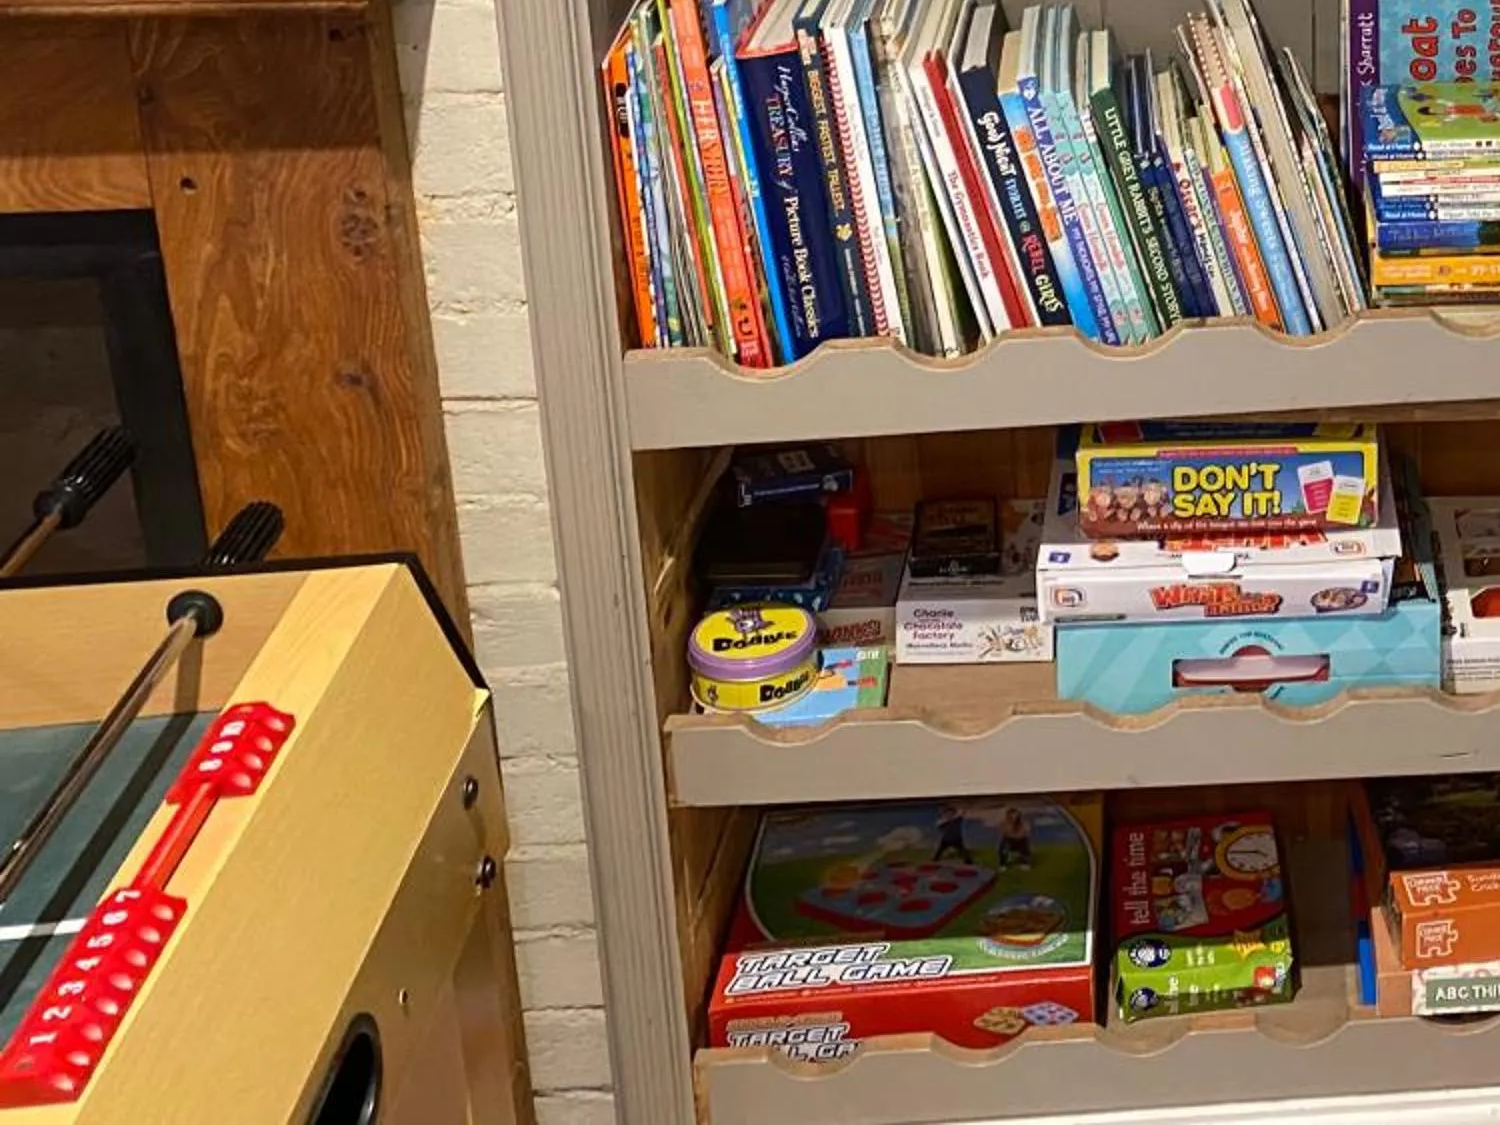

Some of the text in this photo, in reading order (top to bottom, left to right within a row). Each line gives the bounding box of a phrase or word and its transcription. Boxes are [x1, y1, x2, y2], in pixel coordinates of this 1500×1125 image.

[1451, 8, 1477, 40] To
[1356, 12, 1376, 76] Sharratt
[1402, 15, 1439, 81] oat
[772, 63, 809, 153] HarperCollins
[764, 94, 792, 176] TREASURY
[975, 109, 1006, 145] Good
[1027, 103, 1051, 140] ALL
[1039, 141, 1069, 197] ABOUT
[1057, 198, 1078, 226] ME
[1102, 107, 1127, 150] LITTLE
[1117, 149, 1137, 183] GREY
[1127, 182, 1154, 234] RABBIT'S
[1144, 235, 1169, 282] SECOND
[1177, 177, 1203, 231] Oscar's
[782, 195, 805, 244] Picture
[946, 170, 989, 279] The Gymnastics Book
[1252, 197, 1280, 250] Sweets
[793, 247, 812, 283] Book
[1019, 232, 1050, 275] REBEL
[799, 283, 822, 338] Classics
[1031, 271, 1063, 314] GIRLS
[1172, 461, 1280, 493] DON'T
[1173, 490, 1282, 518] SAY IT!
[913, 608, 955, 619] Charlie
[116, 889, 141, 903] 7
[1124, 832, 1150, 925] tell the time
[102, 908, 128, 925] 6
[87, 932, 113, 948] 5
[76, 956, 101, 972] 4
[729, 956, 951, 994] BALL GAME
[738, 944, 890, 974] TARGET
[58, 980, 85, 996] 3
[1434, 986, 1469, 1001] ABC
[43, 1005, 72, 1022] 2
[30, 1031, 58, 1045] 1
[731, 1023, 849, 1049] TARGET
